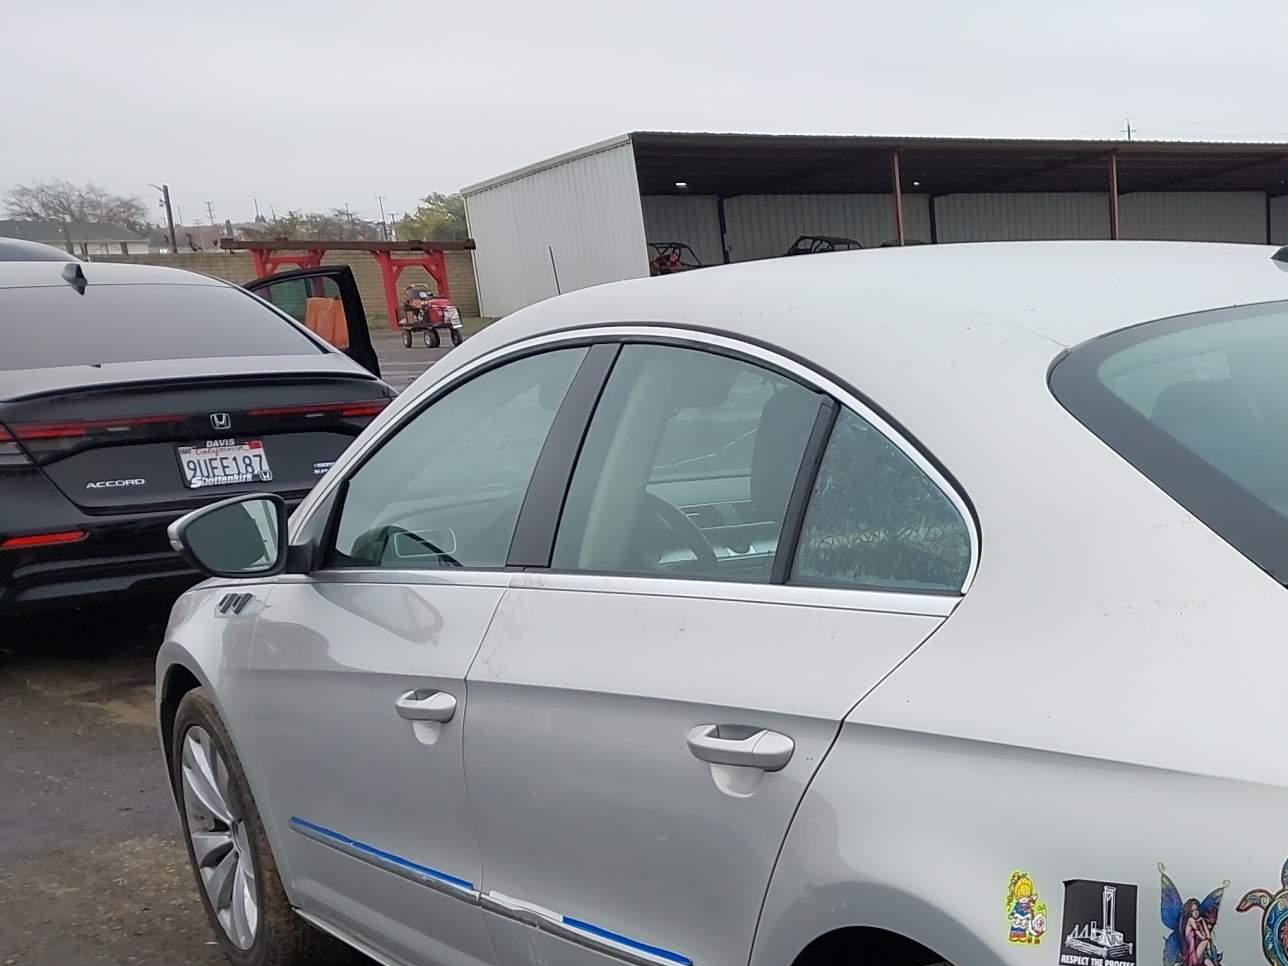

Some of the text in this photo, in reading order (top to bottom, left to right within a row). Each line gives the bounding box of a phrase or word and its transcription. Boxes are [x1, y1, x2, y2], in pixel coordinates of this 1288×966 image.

[206, 438, 235, 448] DAVIS
[86, 478, 145, 489] ACCORD
[1060, 953, 1090, 966] RESPECT
